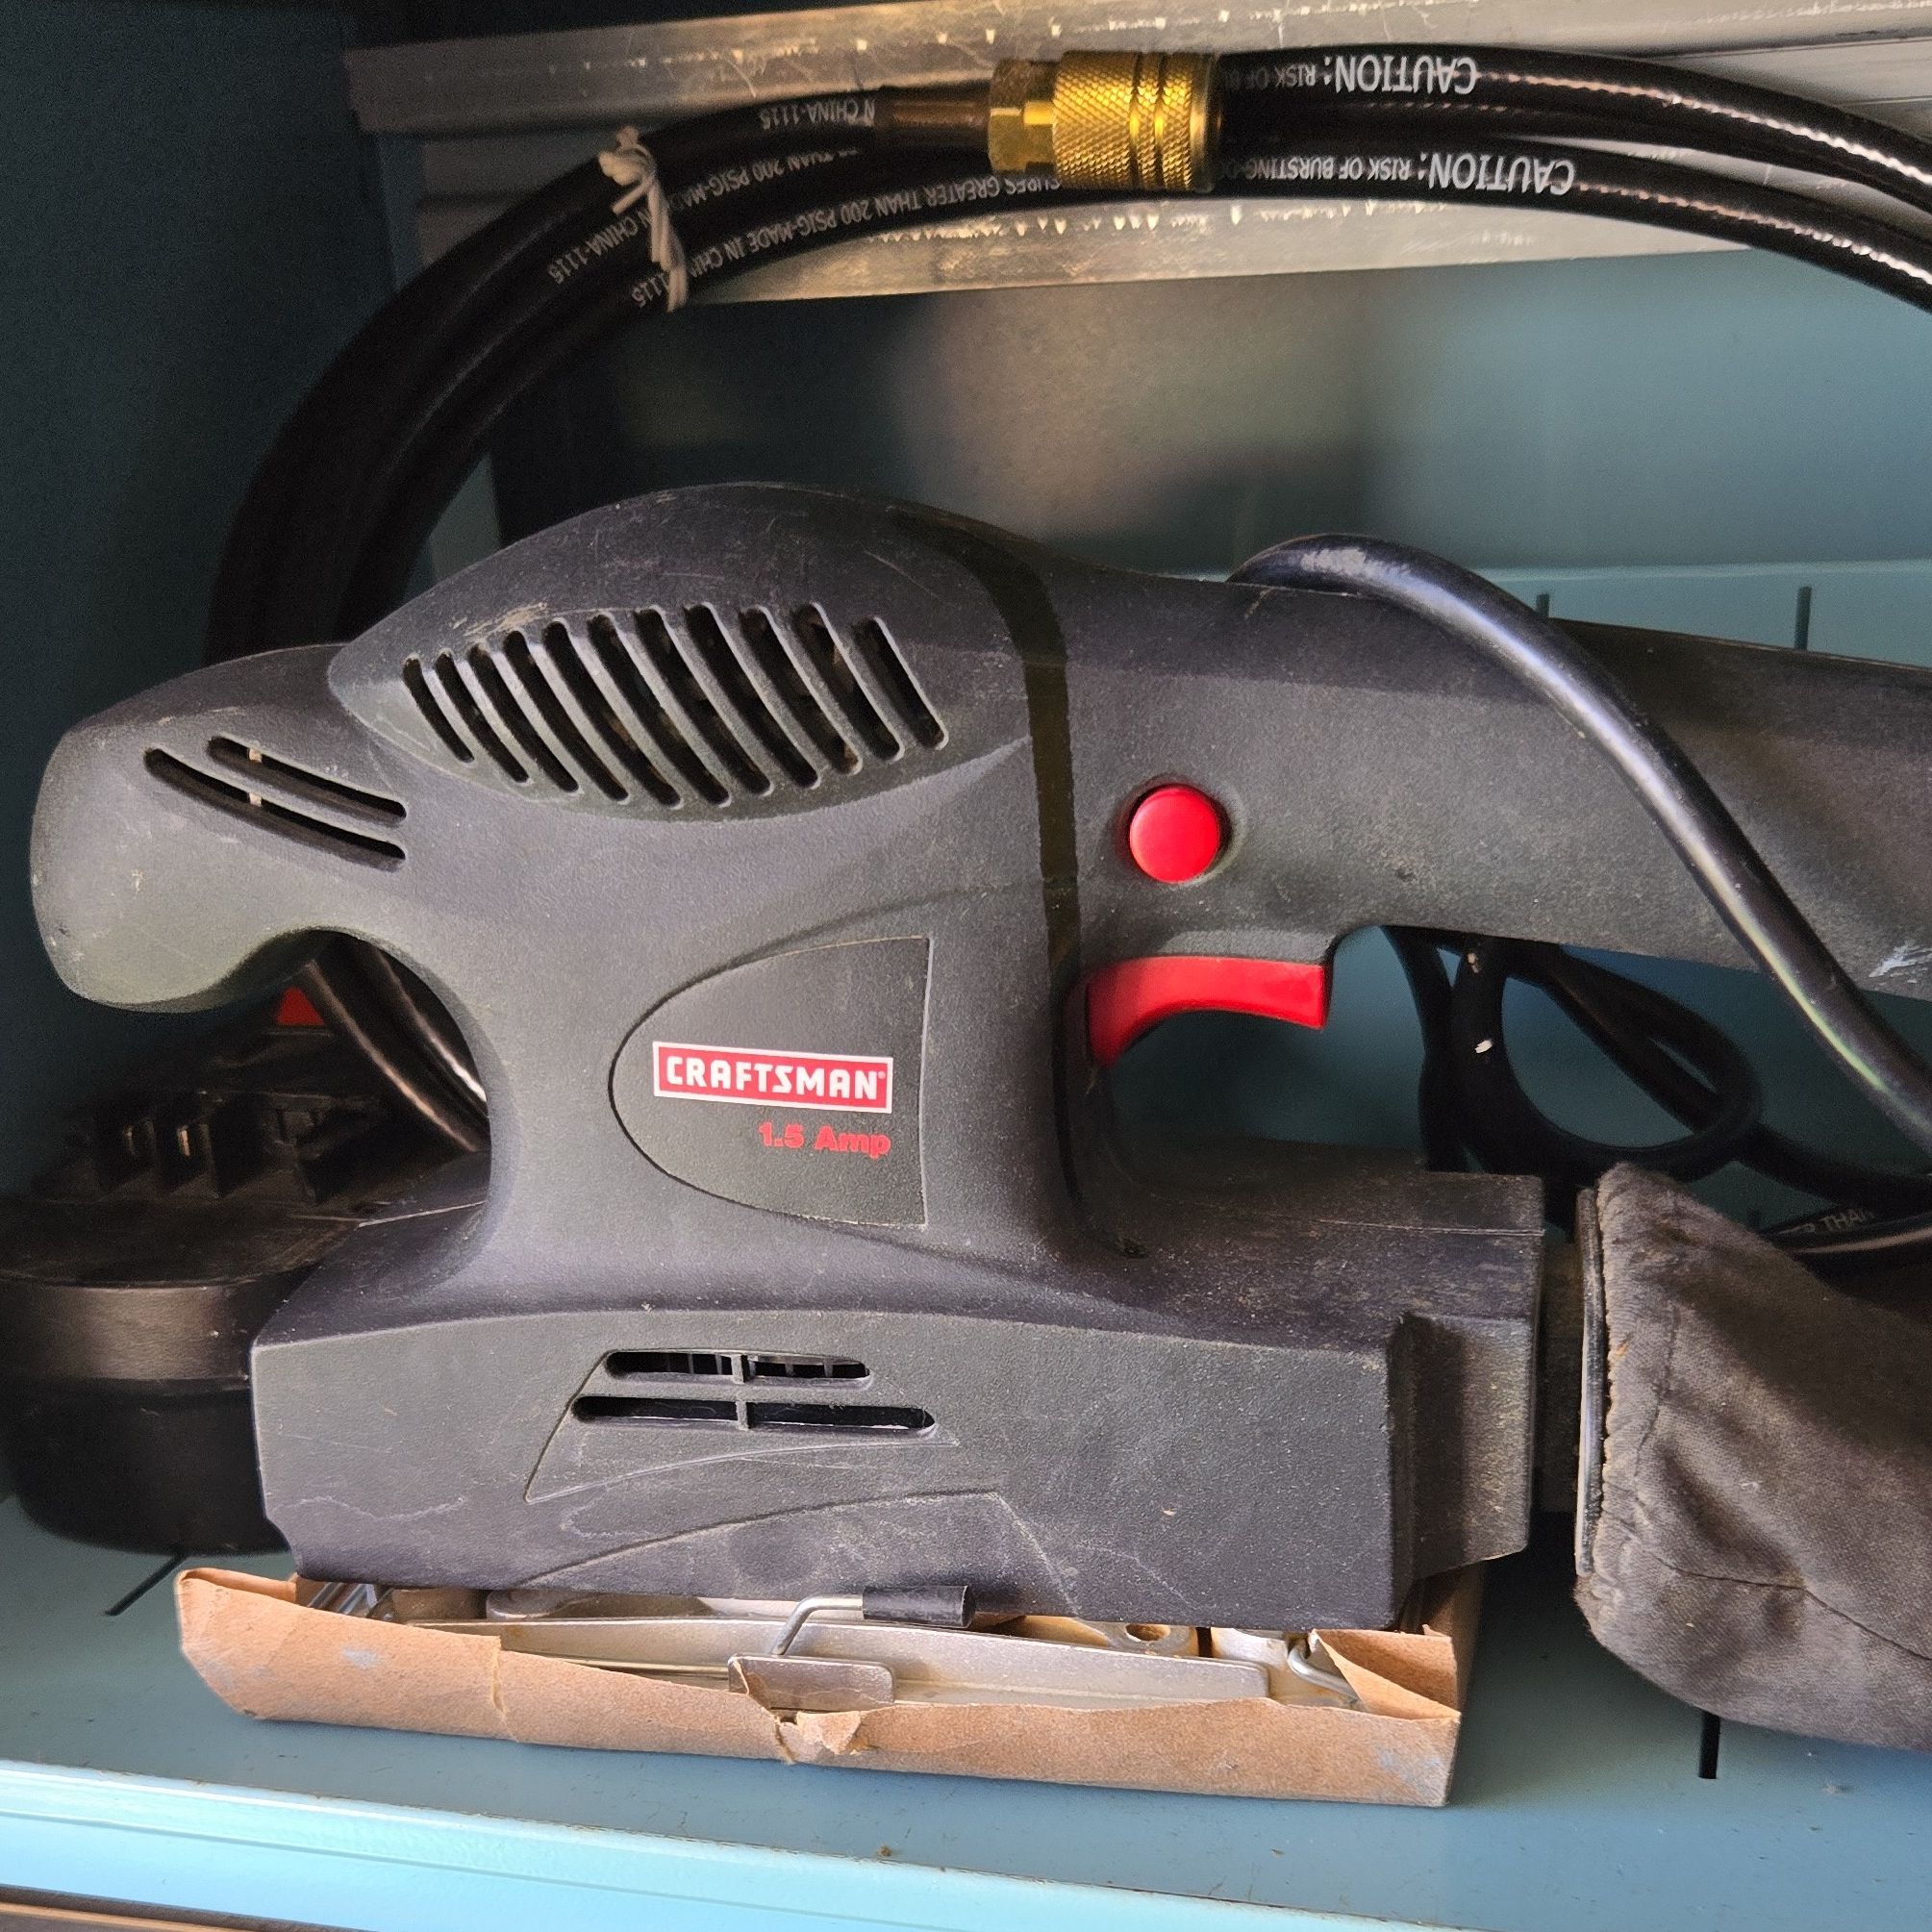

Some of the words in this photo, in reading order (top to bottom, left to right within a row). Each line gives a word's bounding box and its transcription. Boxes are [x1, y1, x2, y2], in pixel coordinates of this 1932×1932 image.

[1274, 63, 1317, 88] RISK
[1324, 54, 1478, 94] CAUTION:
[758, 98, 860, 130] CHINA-1115
[1338, 156, 1364, 181] OF
[1367, 156, 1412, 181] RISK
[1418, 151, 1576, 195] CAUTION:
[872, 189, 922, 217] THAN
[922, 175, 1000, 208] GREATER
[841, 198, 872, 225] 200
[745, 209, 838, 254] PSIG-MADE
[547, 215, 640, 285] CHINA-1115
[723, 237, 745, 263] IN
[665, 1055, 878, 1100] CRAFTSMAN
[758, 1121, 805, 1149] 1.5
[815, 1124, 892, 1159] Amp
